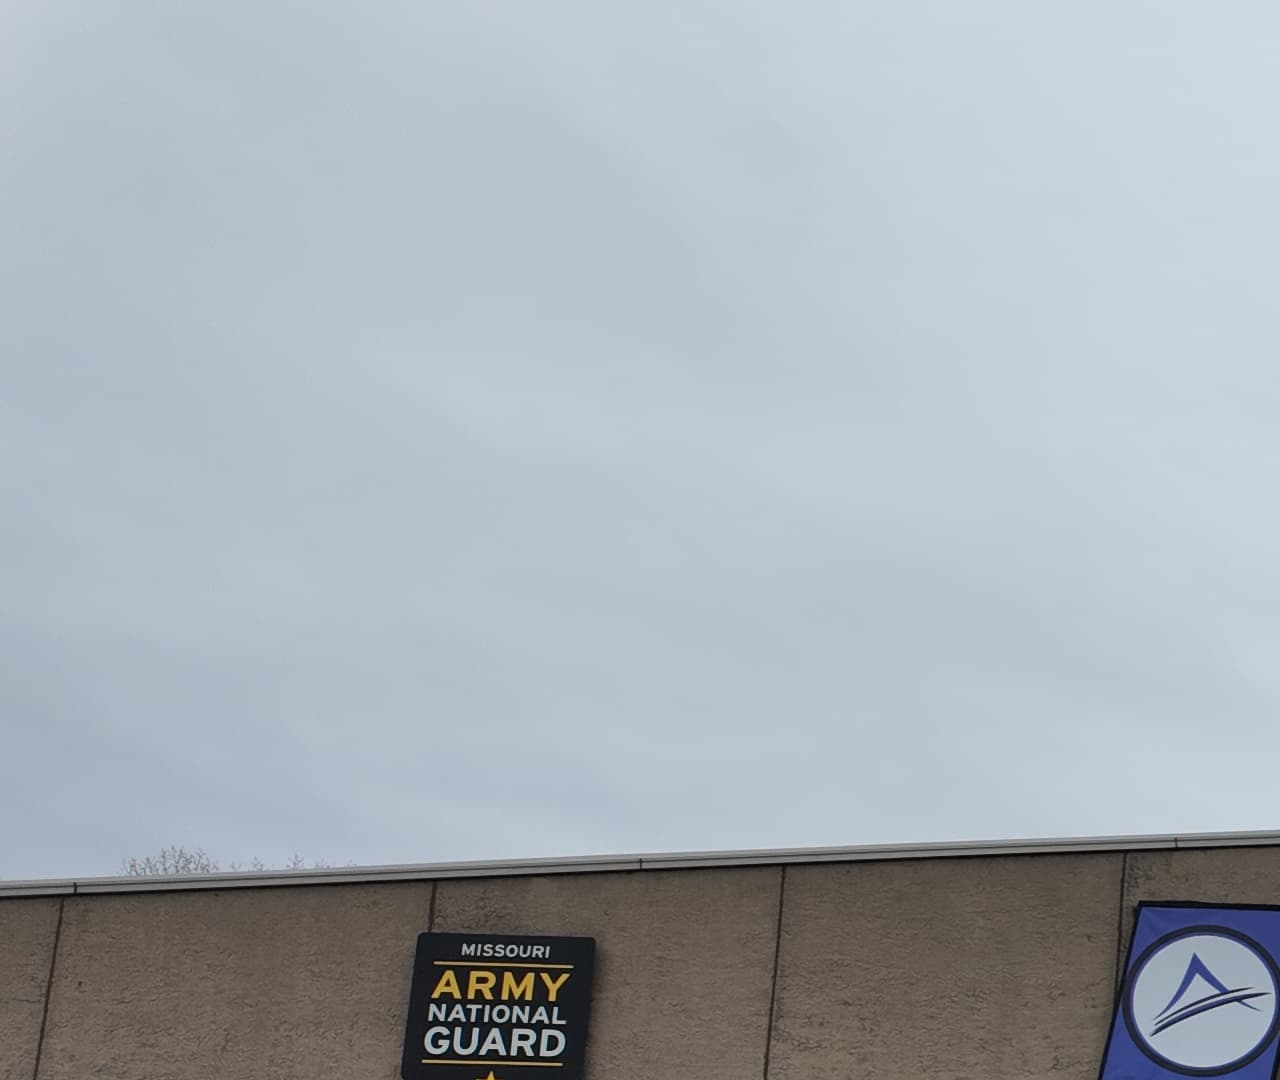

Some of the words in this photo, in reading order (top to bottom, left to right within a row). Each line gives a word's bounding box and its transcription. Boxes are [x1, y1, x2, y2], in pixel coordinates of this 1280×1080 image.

[461, 942, 551, 960] MISSOURI
[431, 970, 571, 1003] ARMY
[426, 1003, 568, 1026] NATIONAL
[422, 1027, 567, 1058] GUARD
